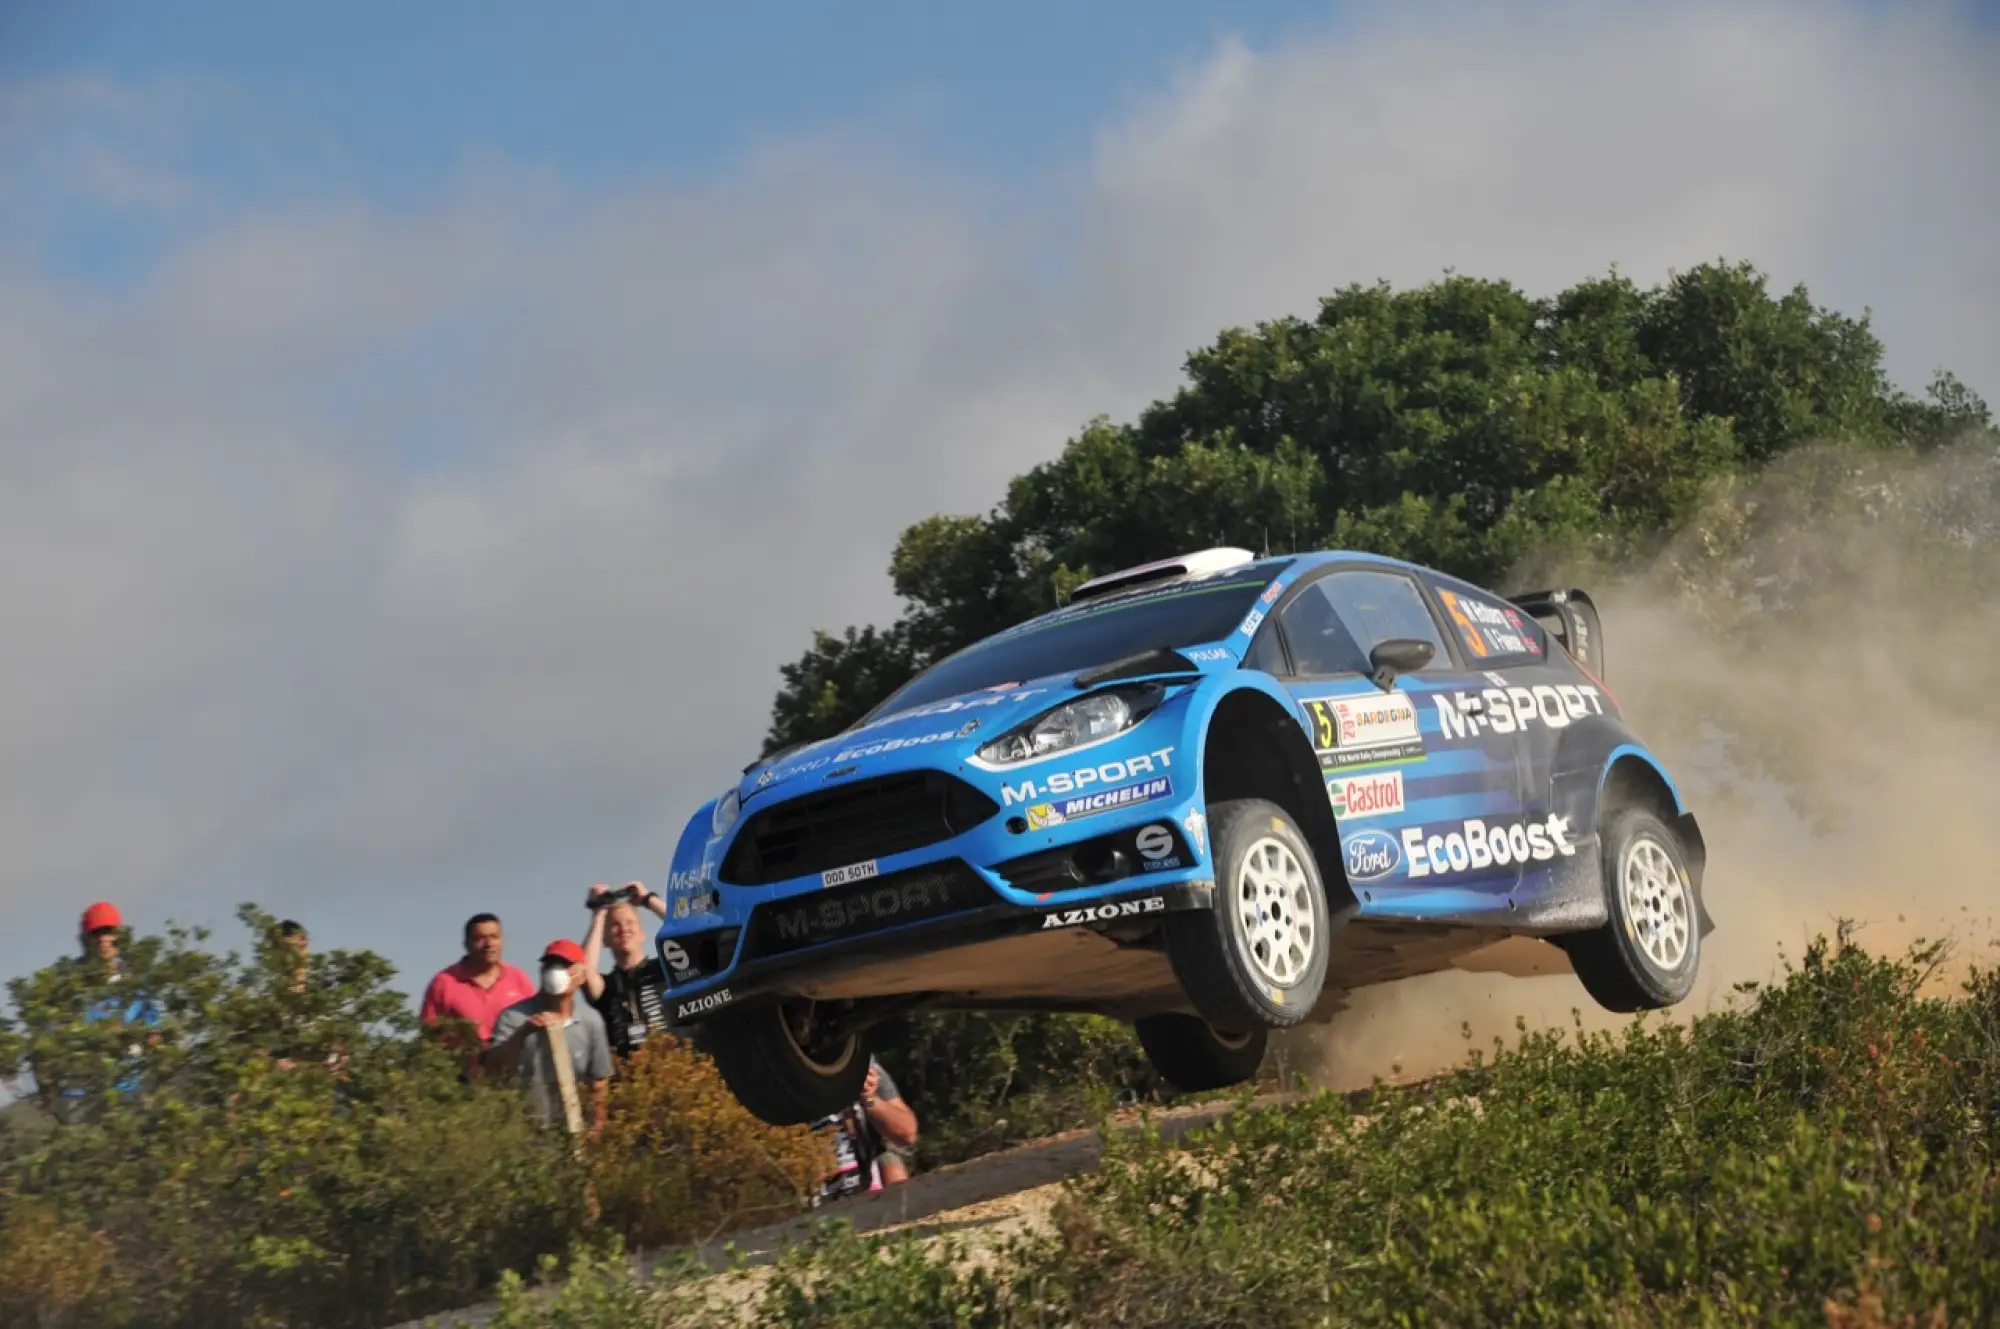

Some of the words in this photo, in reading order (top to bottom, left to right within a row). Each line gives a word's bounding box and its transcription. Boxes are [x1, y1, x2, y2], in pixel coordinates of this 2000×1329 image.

[1312, 701, 1332, 748] 5
[1432, 685, 1604, 740] M-SPORT
[1001, 746, 1175, 807] M-SPORT
[1064, 777, 1168, 815] MICHELIN
[1346, 776, 1402, 814] Castrol
[1348, 837, 1392, 870] Ford
[1401, 812, 1576, 879] EcoBoost
[776, 872, 957, 939] M-SPORT
[1041, 895, 1166, 929] AZIONE
[677, 988, 733, 1019] AZIONE
